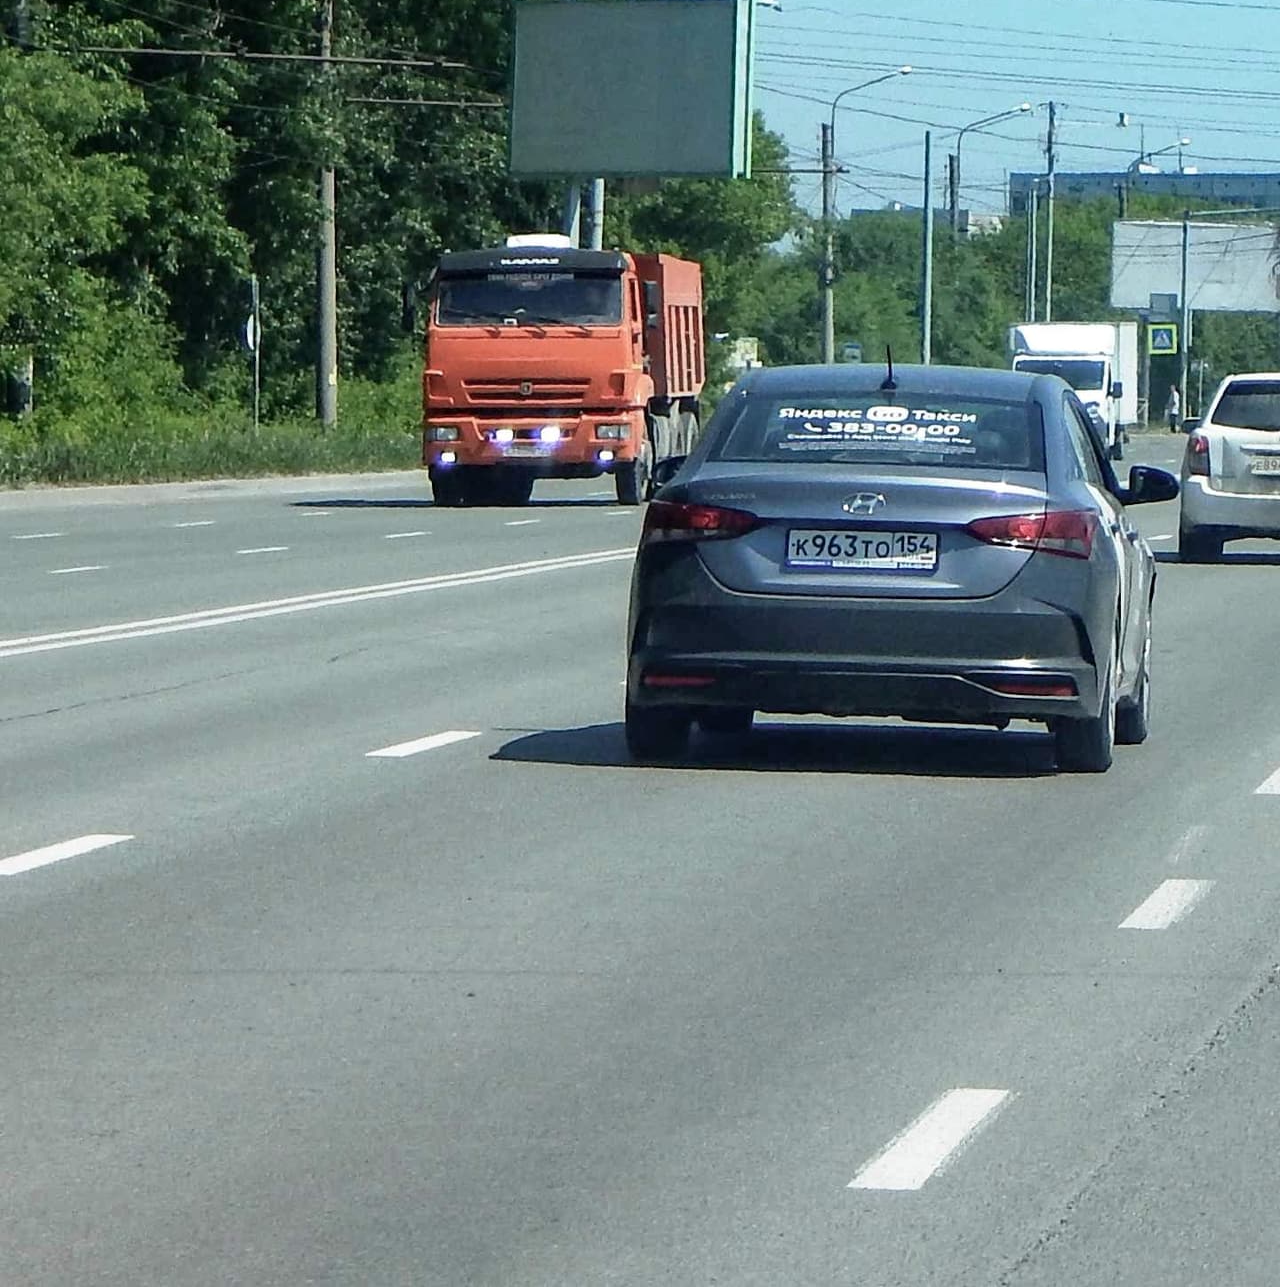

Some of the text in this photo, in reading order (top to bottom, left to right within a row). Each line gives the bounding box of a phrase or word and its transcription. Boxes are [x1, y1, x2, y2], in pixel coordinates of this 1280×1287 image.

[778, 407, 863, 420] Яндекс
[911, 409, 977, 423] Такси
[895, 535, 932, 554] 154
